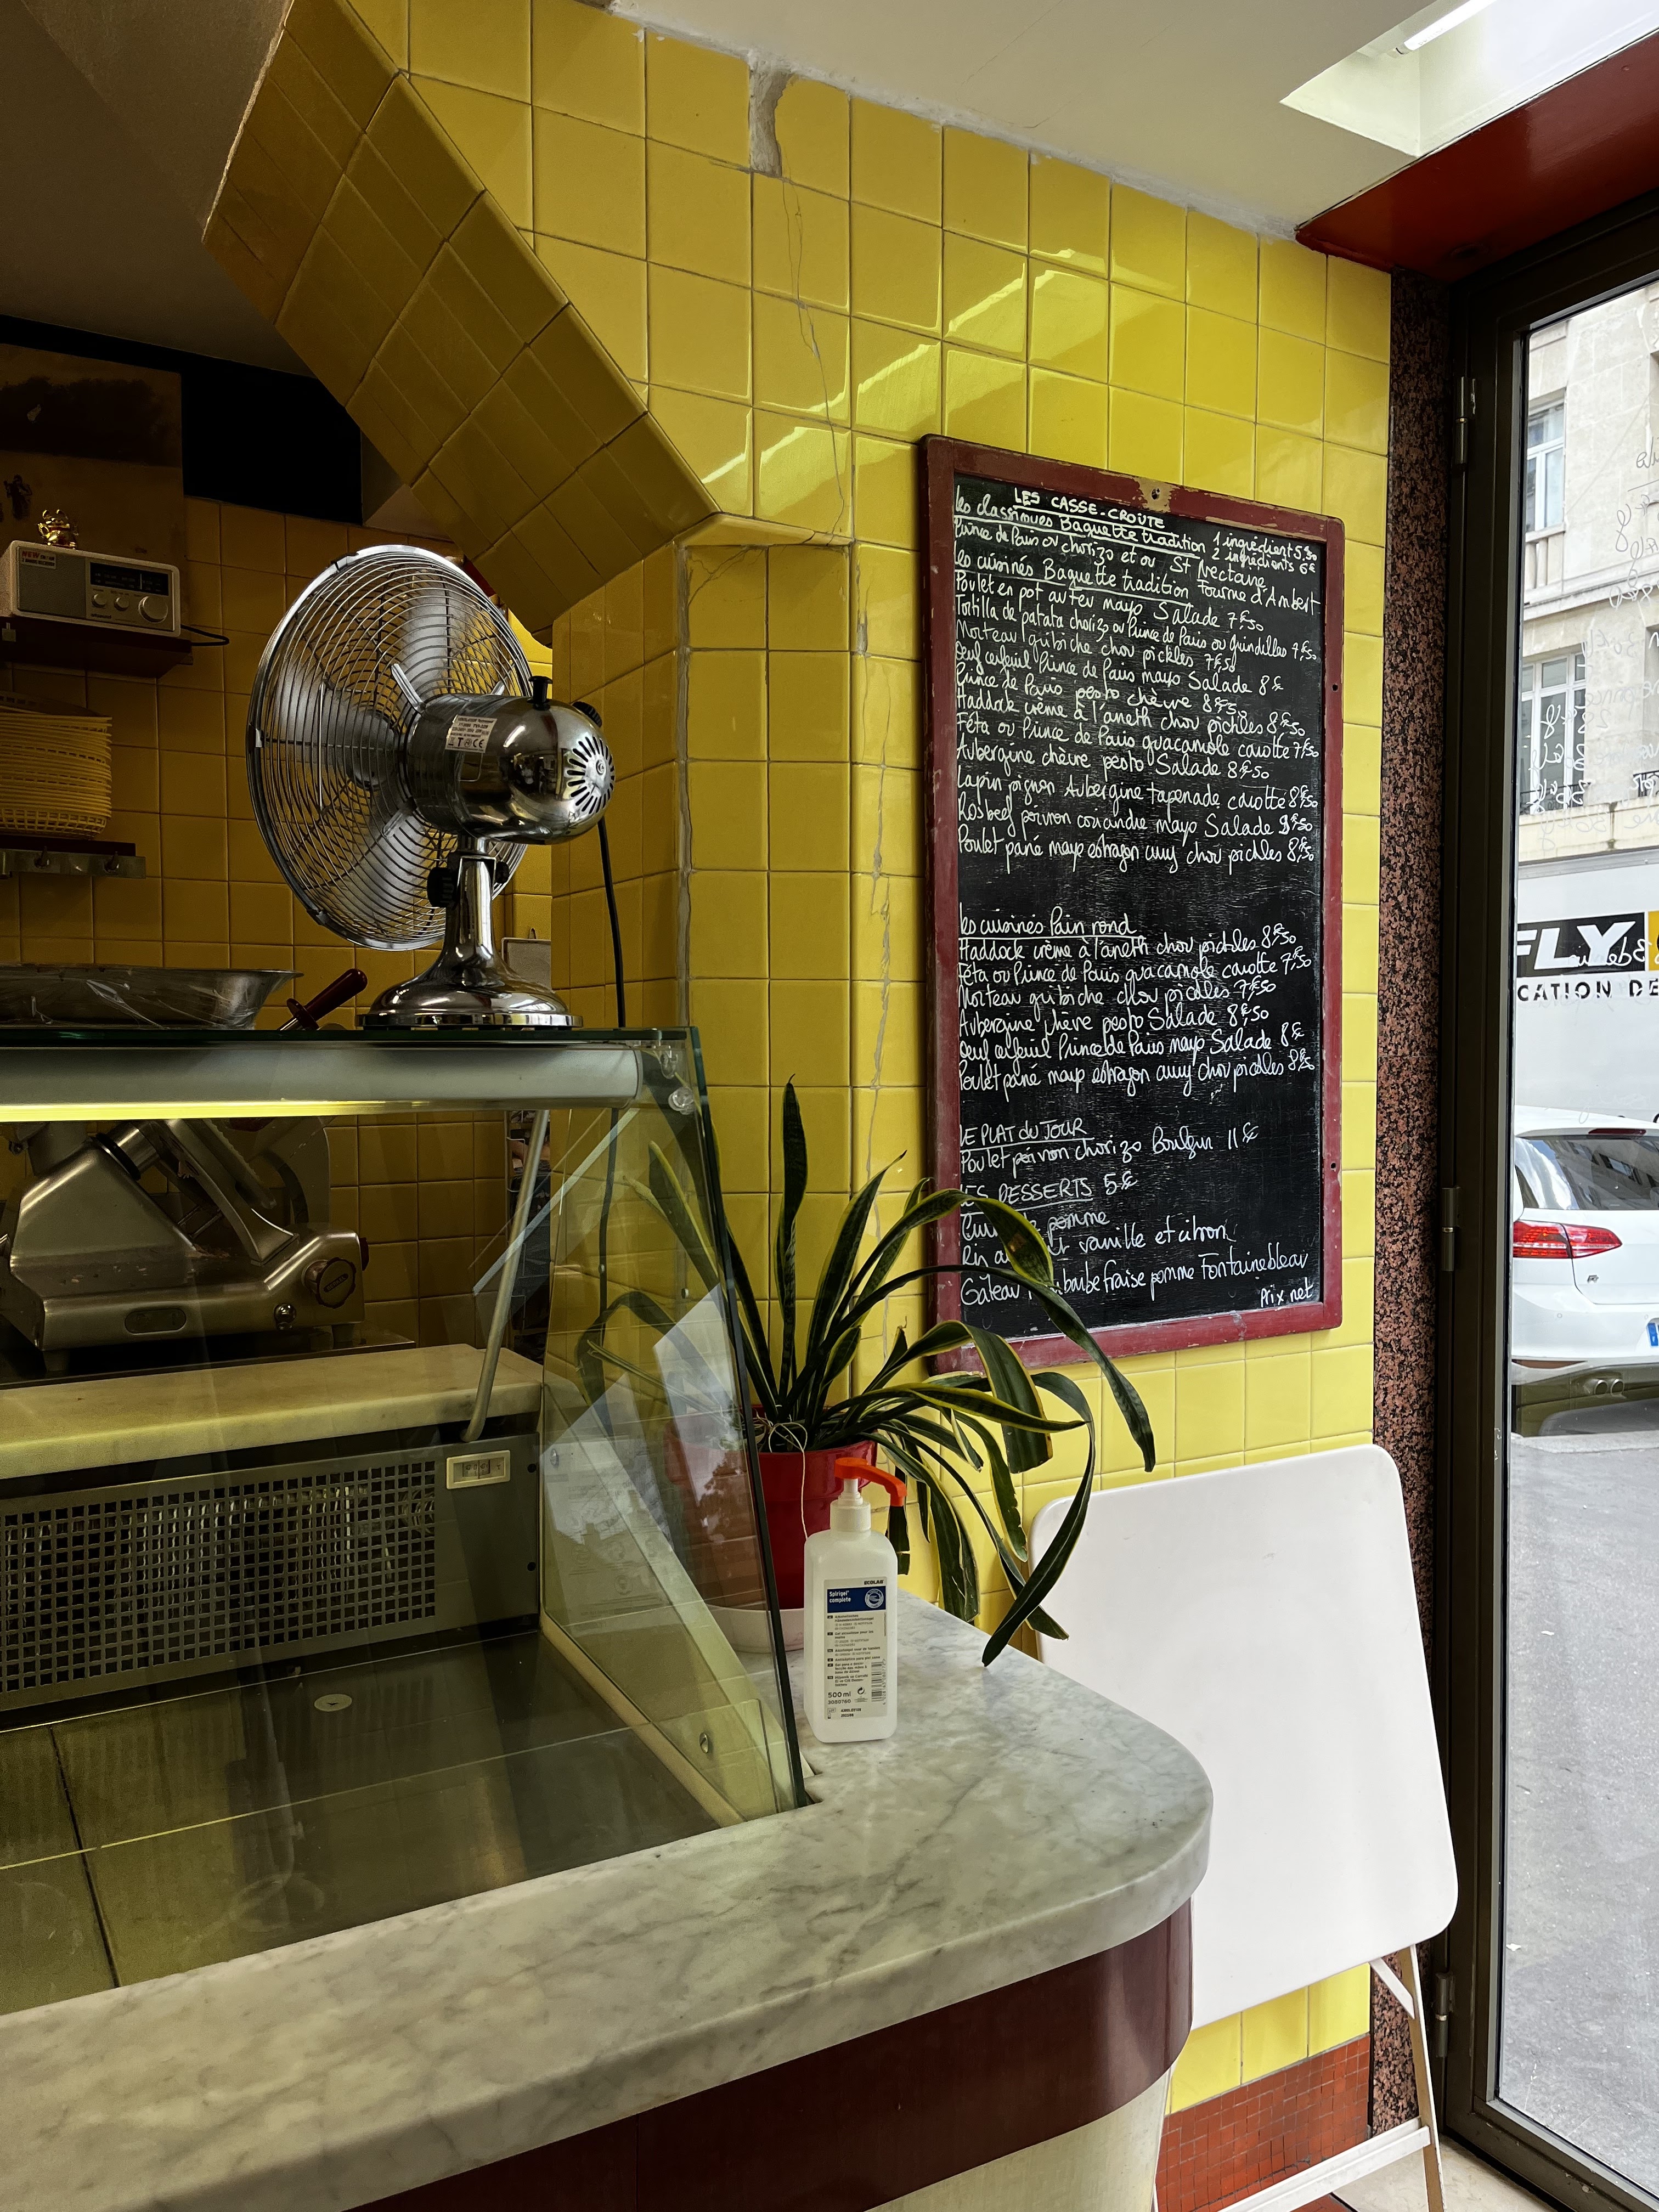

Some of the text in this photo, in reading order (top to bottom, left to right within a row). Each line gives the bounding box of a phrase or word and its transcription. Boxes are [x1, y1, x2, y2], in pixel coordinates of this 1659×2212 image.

[955, 485, 1205, 554] Les Baguette tradition
[1015, 488, 1040, 506] LES
[955, 517, 992, 540] Prince
[996, 524, 1009, 542] de
[1012, 526, 1038, 547] Paris
[1062, 535, 1113, 566] chorizo
[1121, 545, 1137, 563] et
[1170, 556, 1191, 574] St
[1211, 548, 1220, 560] 2
[1299, 563, 1316, 574] 6€
[1213, 531, 1220, 546] 1
[955, 540, 1321, 616] Les cuisinés Baguette tradition Fourme d'Ambert
[956, 570, 1220, 628] Poulet en pot au mayo Salade
[956, 594, 998, 620] Tortilla
[1002, 601, 1017, 621] de
[1022, 603, 1064, 642] patata
[1070, 608, 1108, 642] chorizo
[1128, 616, 1159, 642] Prince
[1163, 626, 1174, 643] de
[1180, 625, 1206, 648] Paris
[956, 619, 1016, 642] Morteau
[1143, 646, 1193, 669] pickles
[956, 662, 1192, 709] Prince de Paris pesto chèvre
[1039, 651, 1284, 695] Prince de Paris mayo Salade 8€
[957, 687, 1019, 712] Haddock
[1025, 697, 1068, 718] crème
[1207, 715, 1263, 742] pickles
[957, 712, 990, 735] Féta
[1023, 716, 1069, 739] Prince
[1074, 722, 1092, 744] de
[1098, 725, 1135, 748] Paris
[1142, 734, 1229, 765] guacamole
[1238, 732, 1290, 759] carotte
[957, 732, 1221, 782] Aubergine chèvre pesto Salade
[957, 765, 1286, 823] Lapin pignon Aubergine tapenade carotte
[1021, 805, 1274, 847] poivron coriandre mayo Salade
[958, 823, 1005, 854] Poulet
[1005, 835, 1043, 873] pané
[1049, 840, 1084, 872] mayo
[1088, 833, 1139, 872] estragon
[1146, 845, 1178, 873] curry
[1228, 839, 1282, 875] pickles
[960, 902, 1137, 936] Les cuisinés Pain rond
[960, 938, 1025, 961] Haddock
[1034, 940, 1073, 959] crème
[1079, 936, 1090, 957] à
[1199, 929, 1256, 960] pickles
[958, 961, 989, 986] Féta
[1014, 961, 1057, 985] Prince
[1062, 963, 1077, 982] de
[1083, 960, 1119, 982] Paris
[1125, 956, 1214, 997] guacamole
[1222, 951, 1278, 978] carotte
[958, 984, 1021, 1009] Morteau
[1165, 979, 1229, 1017] pickles
[960, 1002, 1217, 1056] Aubergine pesto Salade
[1059, 1033, 1107, 1060] Prince
[1107, 1035, 1125, 1054] de
[1128, 1030, 1164, 1056] Paris
[1170, 1035, 1205, 1066] mayo
[1210, 1028, 1272, 1054] Salade
[1281, 1022, 1304, 1046] 8€
[959, 1059, 1001, 1091] Poulet
[1003, 1063, 1041, 1102] pané
[1048, 1068, 1085, 1093] mayo
[1091, 1060, 1150, 1096] estragon
[1156, 1065, 1192, 1096] curry
[1233, 1052, 1284, 1092] pickles
[981, 1124, 1015, 1146] PLAT
[1019, 1120, 1038, 1140] du
[1040, 1118, 1087, 1139] JOUR
[961, 1138, 1141, 1178] Poulet poivron chorizo
[999, 1171, 1138, 1205] DESSERTS 5€
[1047, 1211, 1110, 1246] pomme
[1079, 1222, 1146, 1254] vanille
[1155, 1215, 1176, 1244] et
[1178, 1215, 1228, 1242] citron
[326, 1276, 346, 1290] BERKEL
[961, 1275, 1020, 1306] Gâteau
[1104, 1260, 1146, 1293] fraise
[1151, 1267, 1194, 1301] pomme
[1198, 1243, 1308, 1280] Fontainebleau
[1290, 1277, 1313, 1301] net
